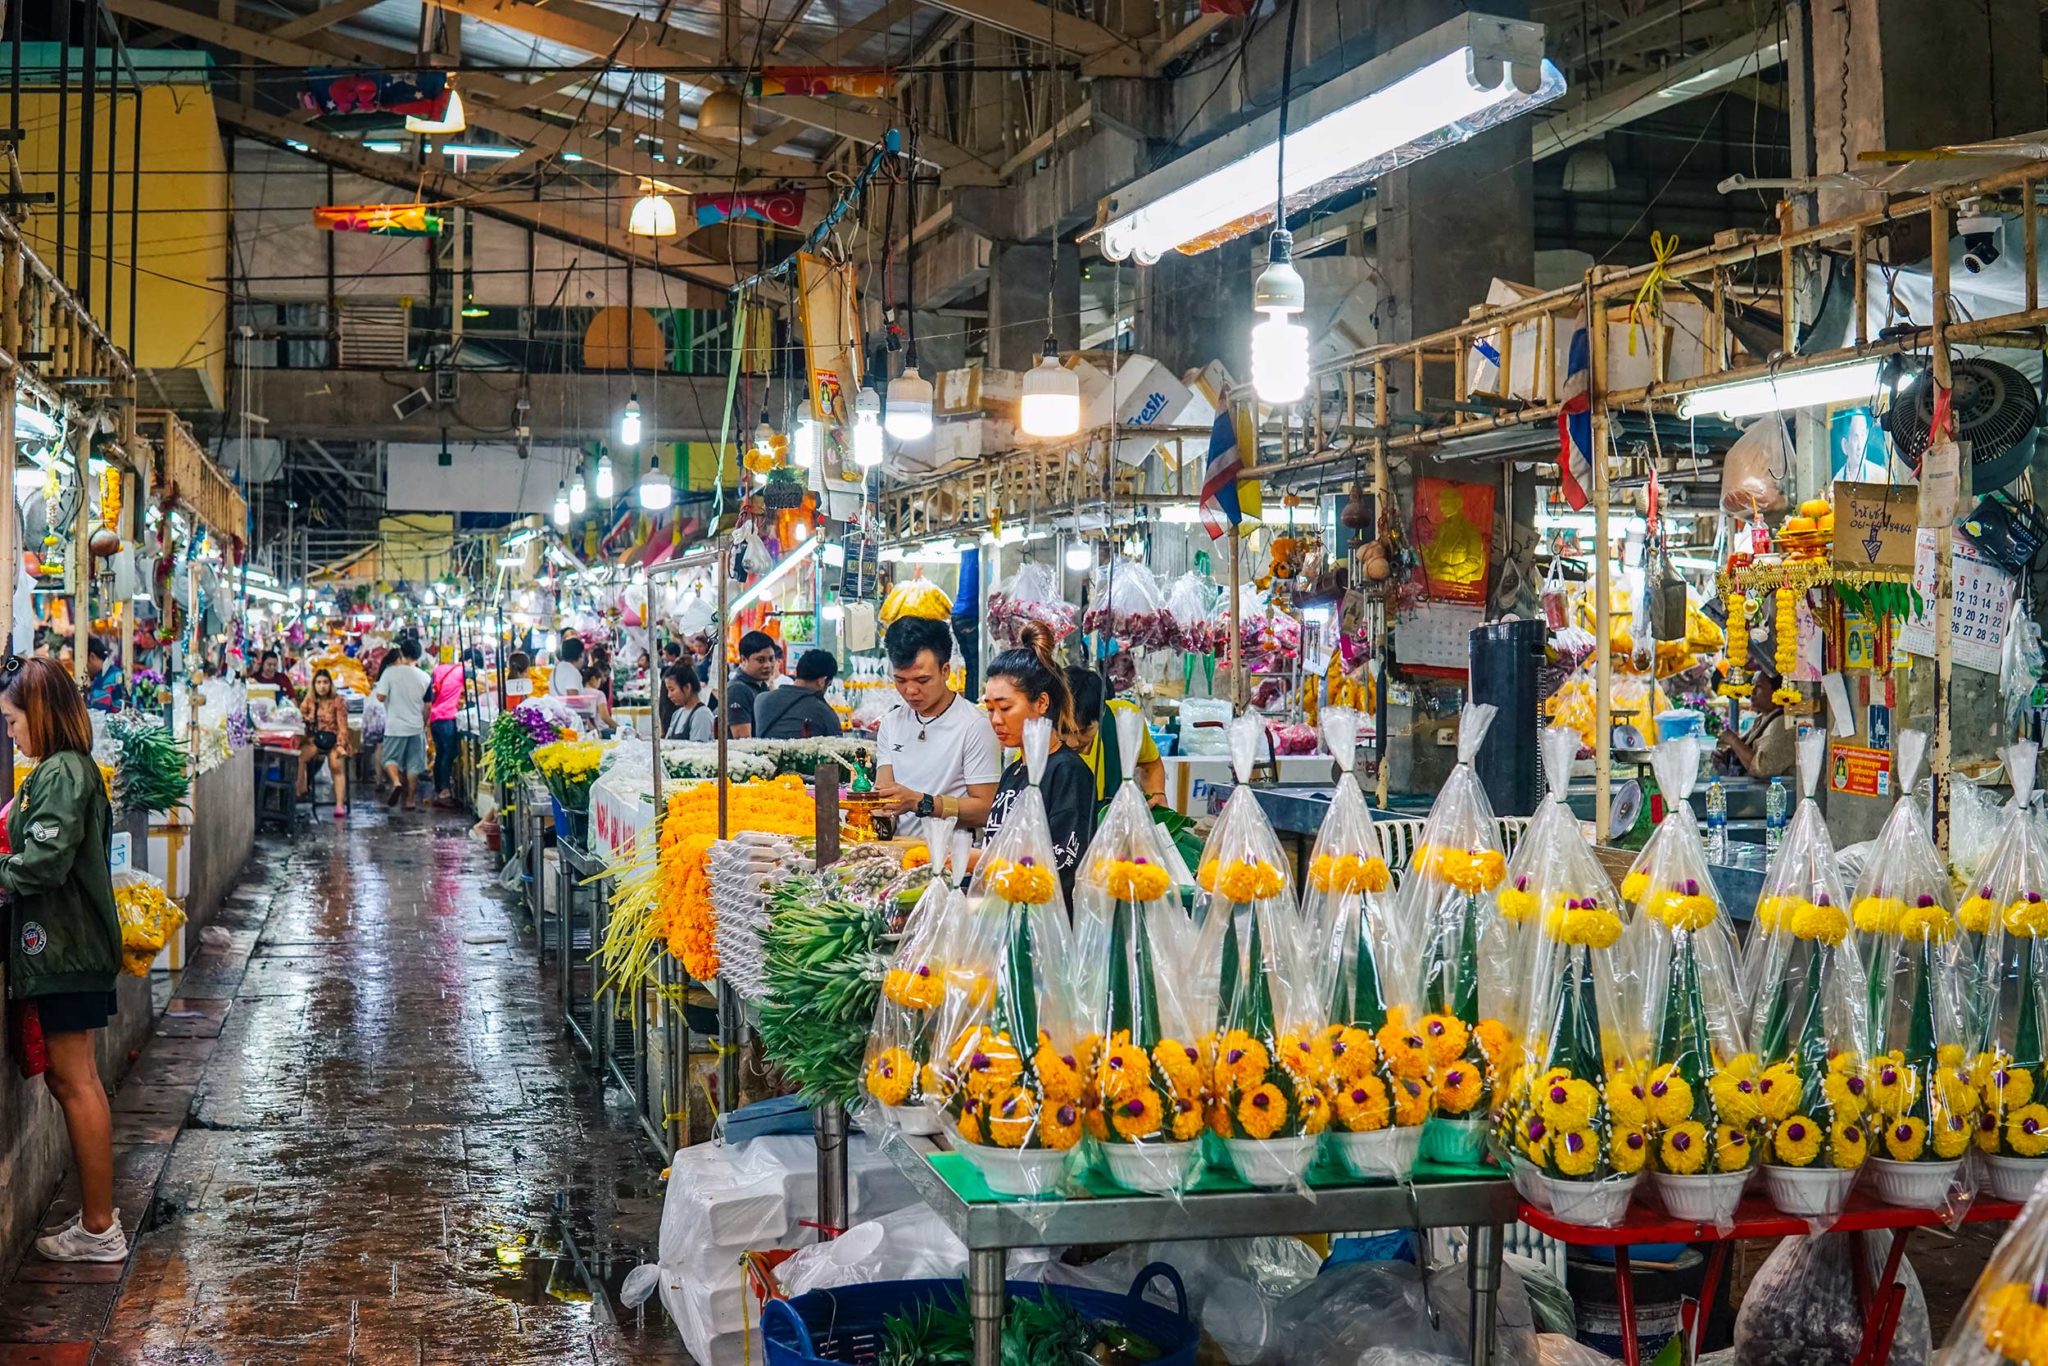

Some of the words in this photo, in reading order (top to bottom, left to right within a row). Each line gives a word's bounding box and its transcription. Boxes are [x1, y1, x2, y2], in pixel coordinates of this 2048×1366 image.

[1960, 545, 1976, 556] 12
[1918, 565, 1925, 575] 2
[1959, 576, 1966, 586] 5
[1972, 579, 1979, 590] 6
[1986, 583, 1992, 593] 7
[1916, 580, 1922, 591] 9
[1955, 591, 1965, 602] 12
[1968, 594, 1978, 606] 13
[1981, 598, 1991, 609] 14
[1995, 602, 2004, 613] 15
[1926, 599, 1936, 610] 17
[1953, 606, 1963, 618] 19
[1965, 609, 1976, 621] 20
[1979, 613, 1989, 624] 21
[1992, 616, 2002, 628] 22
[1951, 621, 1960, 633] 26
[1963, 625, 1973, 636] 27
[1976, 628, 1986, 640] 28
[1989, 632, 2000, 643] 29
